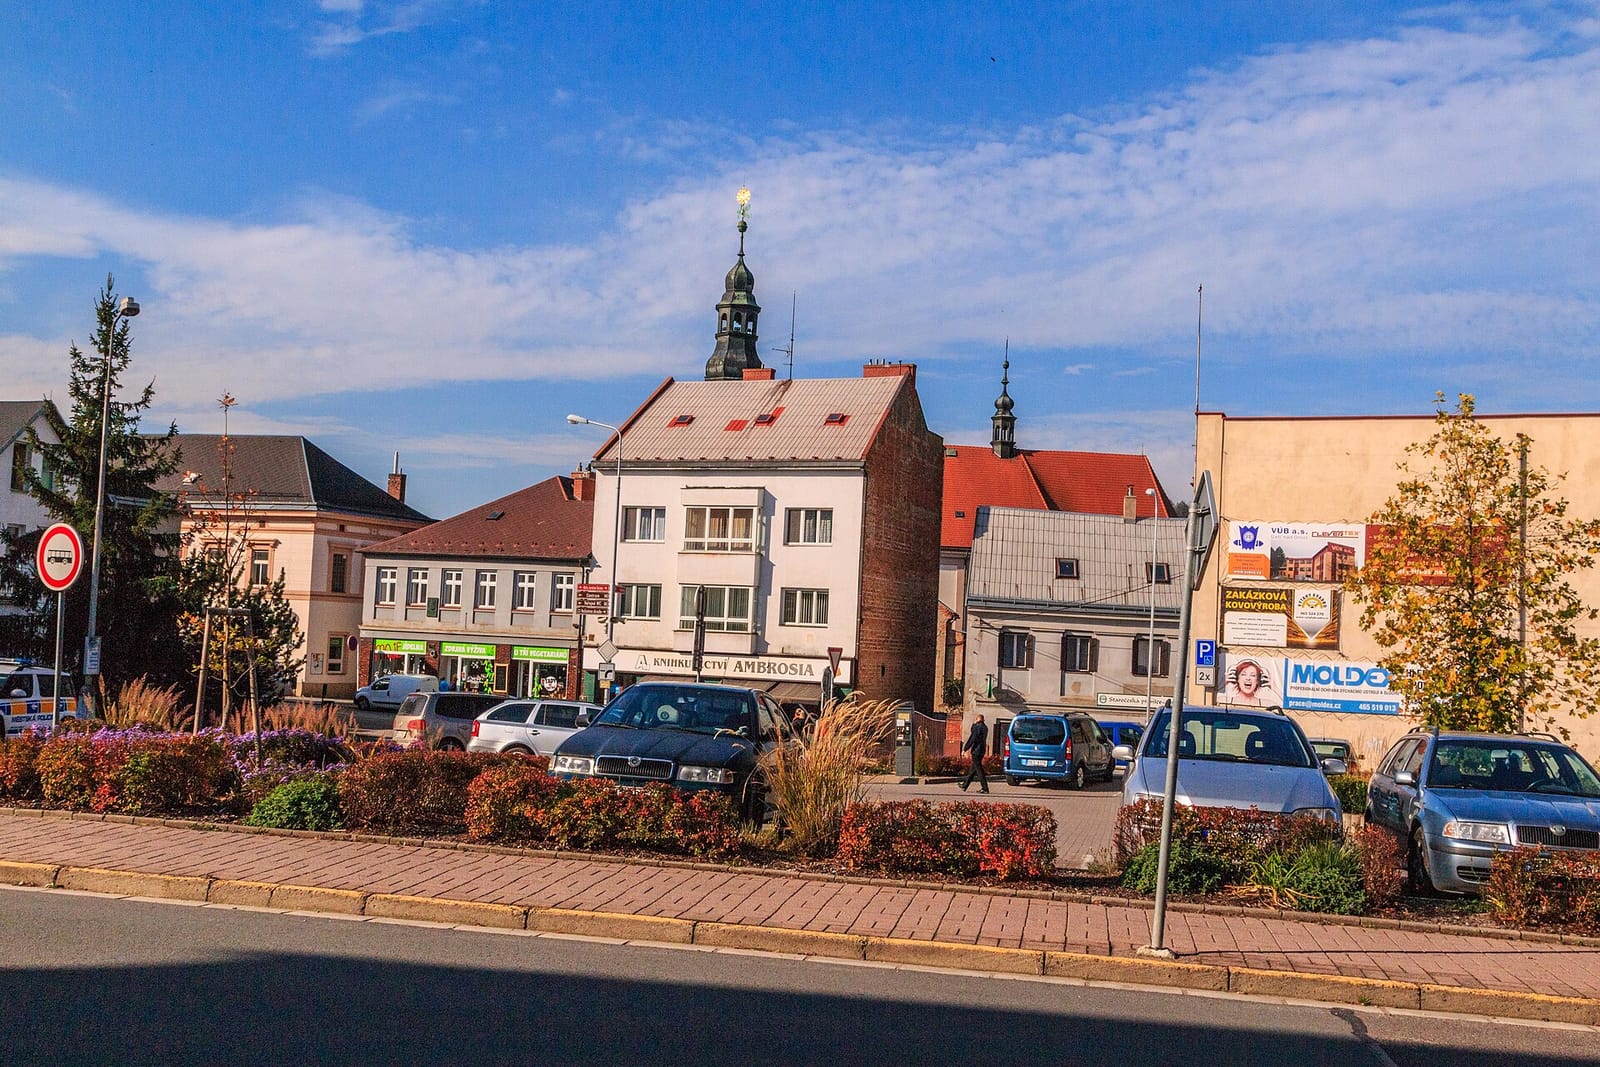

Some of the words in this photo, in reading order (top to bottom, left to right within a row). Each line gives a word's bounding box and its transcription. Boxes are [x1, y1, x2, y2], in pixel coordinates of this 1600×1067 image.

[1271, 526, 1290, 535] VÚB
[1225, 590, 1287, 601] ZAKÁZKOVÁ
[1225, 601, 1287, 610] KOVOVÝROBA
[1199, 642, 1211, 658] P
[653, 657, 728, 670] KNIHKUCTVÍ
[733, 660, 814, 677] AMBROSIA
[1199, 671, 1211, 681] 2x
[1358, 703, 1371, 711] 465
